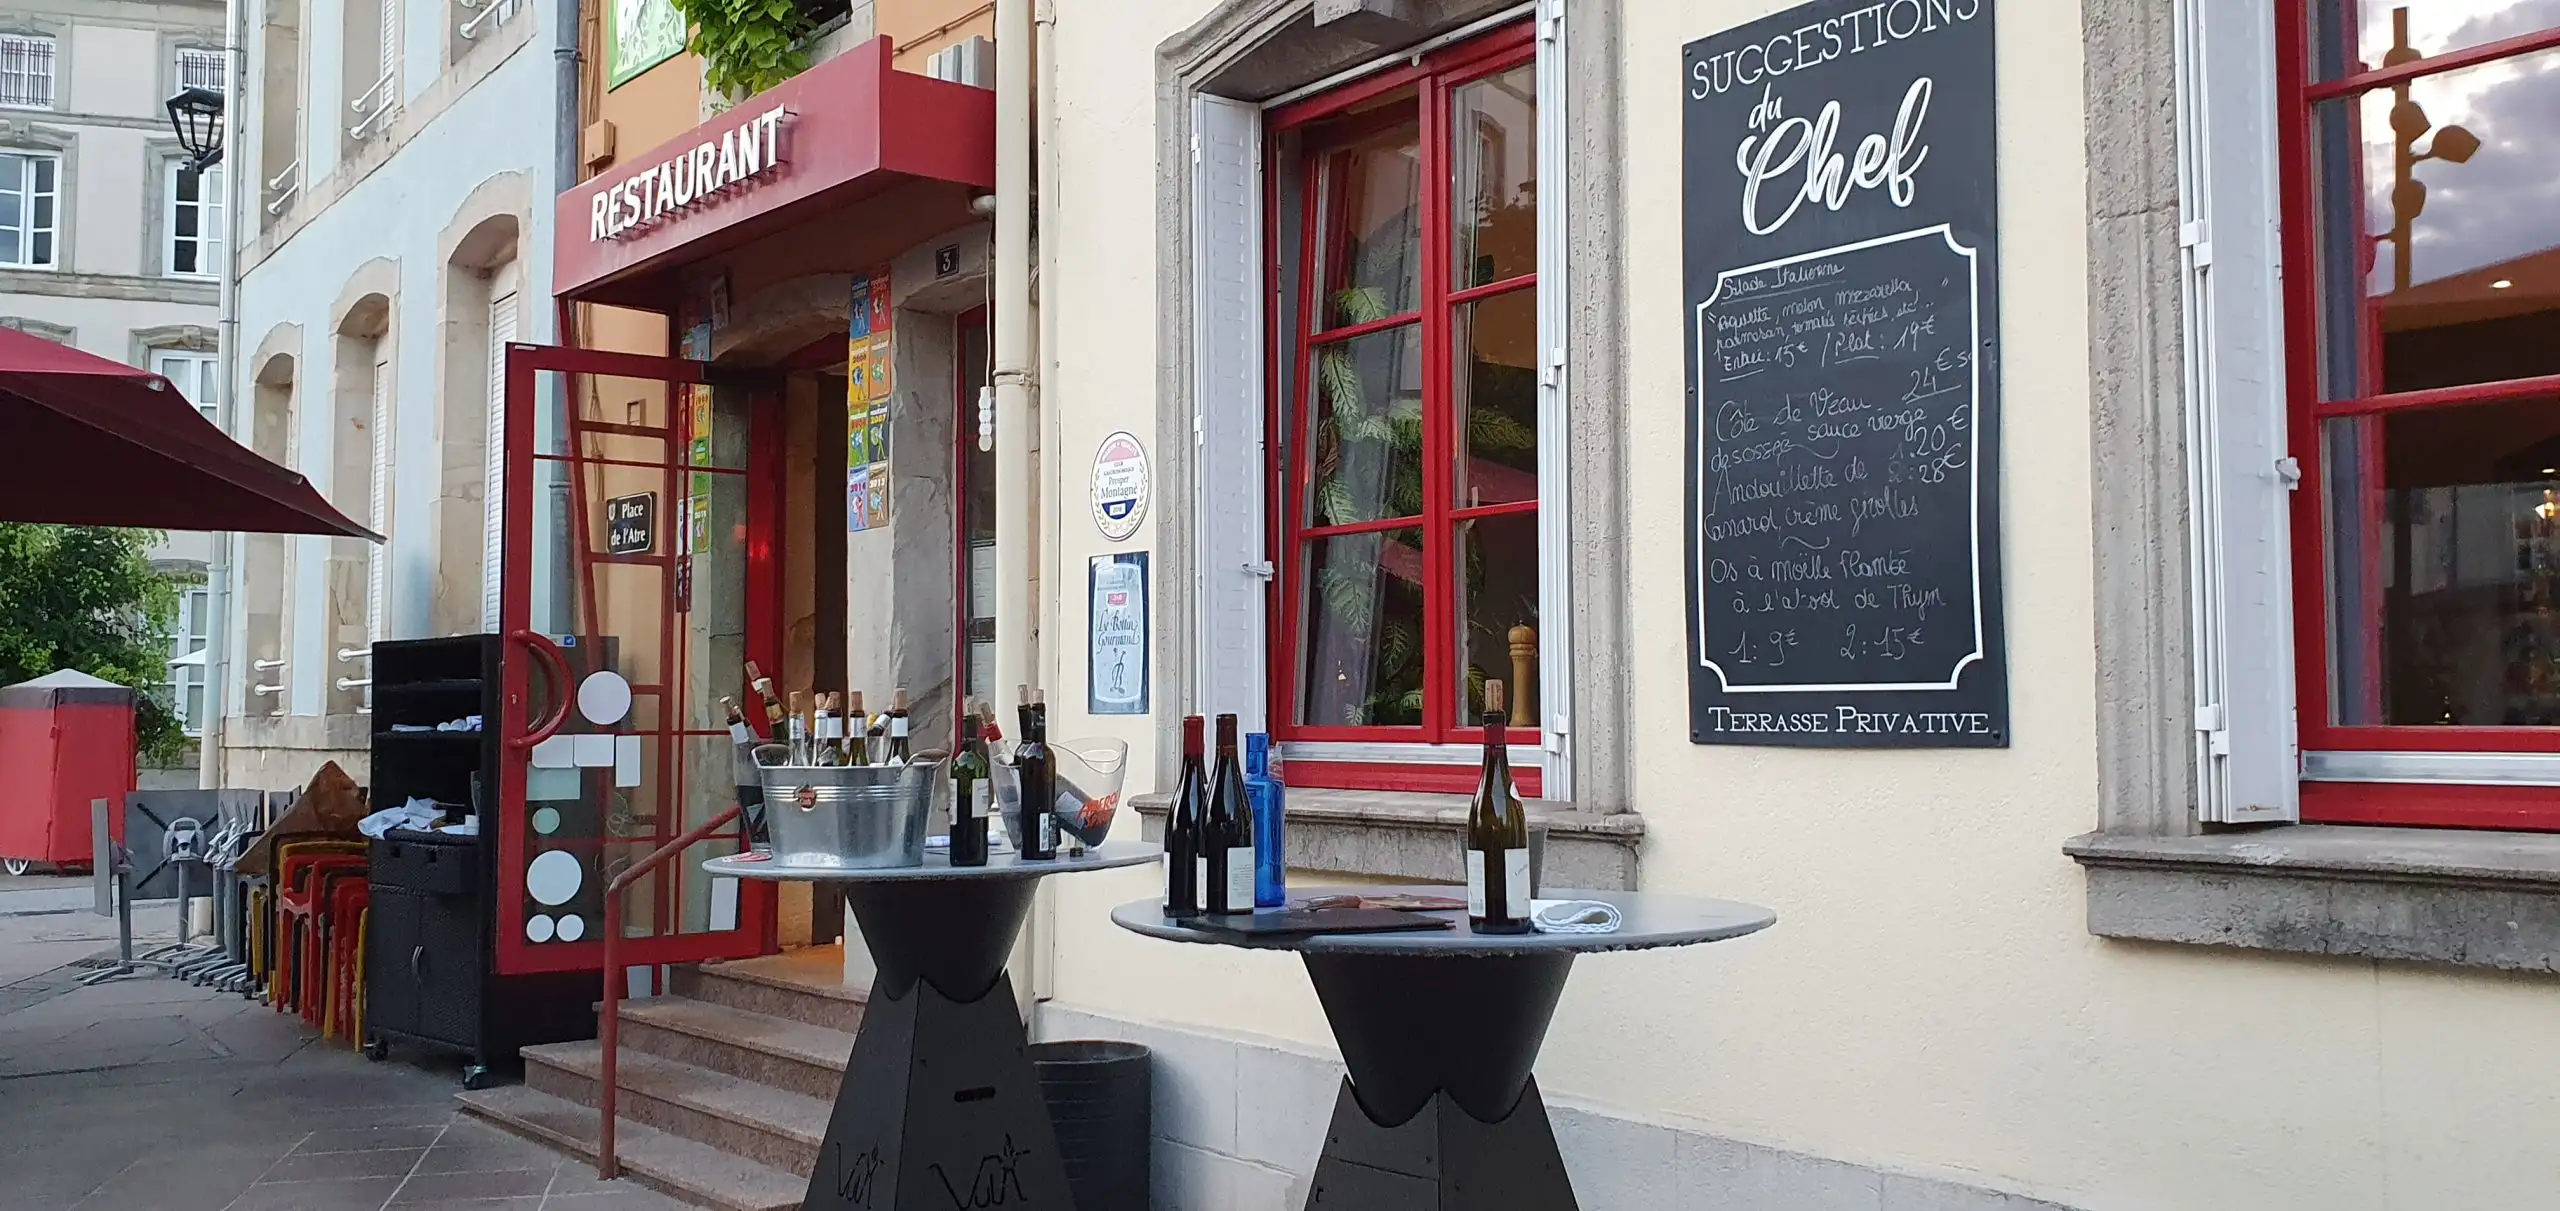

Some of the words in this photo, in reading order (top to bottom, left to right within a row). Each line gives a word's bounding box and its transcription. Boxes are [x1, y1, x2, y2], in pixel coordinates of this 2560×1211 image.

[1748, 82, 1783, 132] du
[590, 103, 785, 242] RESTAURANT
[1736, 77, 1933, 236] Chef
[943, 252, 951, 271] 3
[1722, 276, 1767, 300] Salade
[1783, 296, 1825, 317] melon
[1773, 394, 1803, 425] de
[1809, 386, 1872, 418] Veau
[1807, 416, 1863, 441] sauce
[1868, 405, 1928, 443] vierge
[1845, 456, 1868, 484] de
[622, 501, 644, 519] Place
[1785, 501, 1843, 527] crème
[1850, 486, 1920, 538] girolles
[611, 528, 621, 546] de
[1710, 557, 1738, 584] Os
[1747, 555, 1764, 582] à
[1733, 591, 1751, 614] à
[1855, 588, 1880, 609] de
[1887, 582, 1947, 622] Thym
